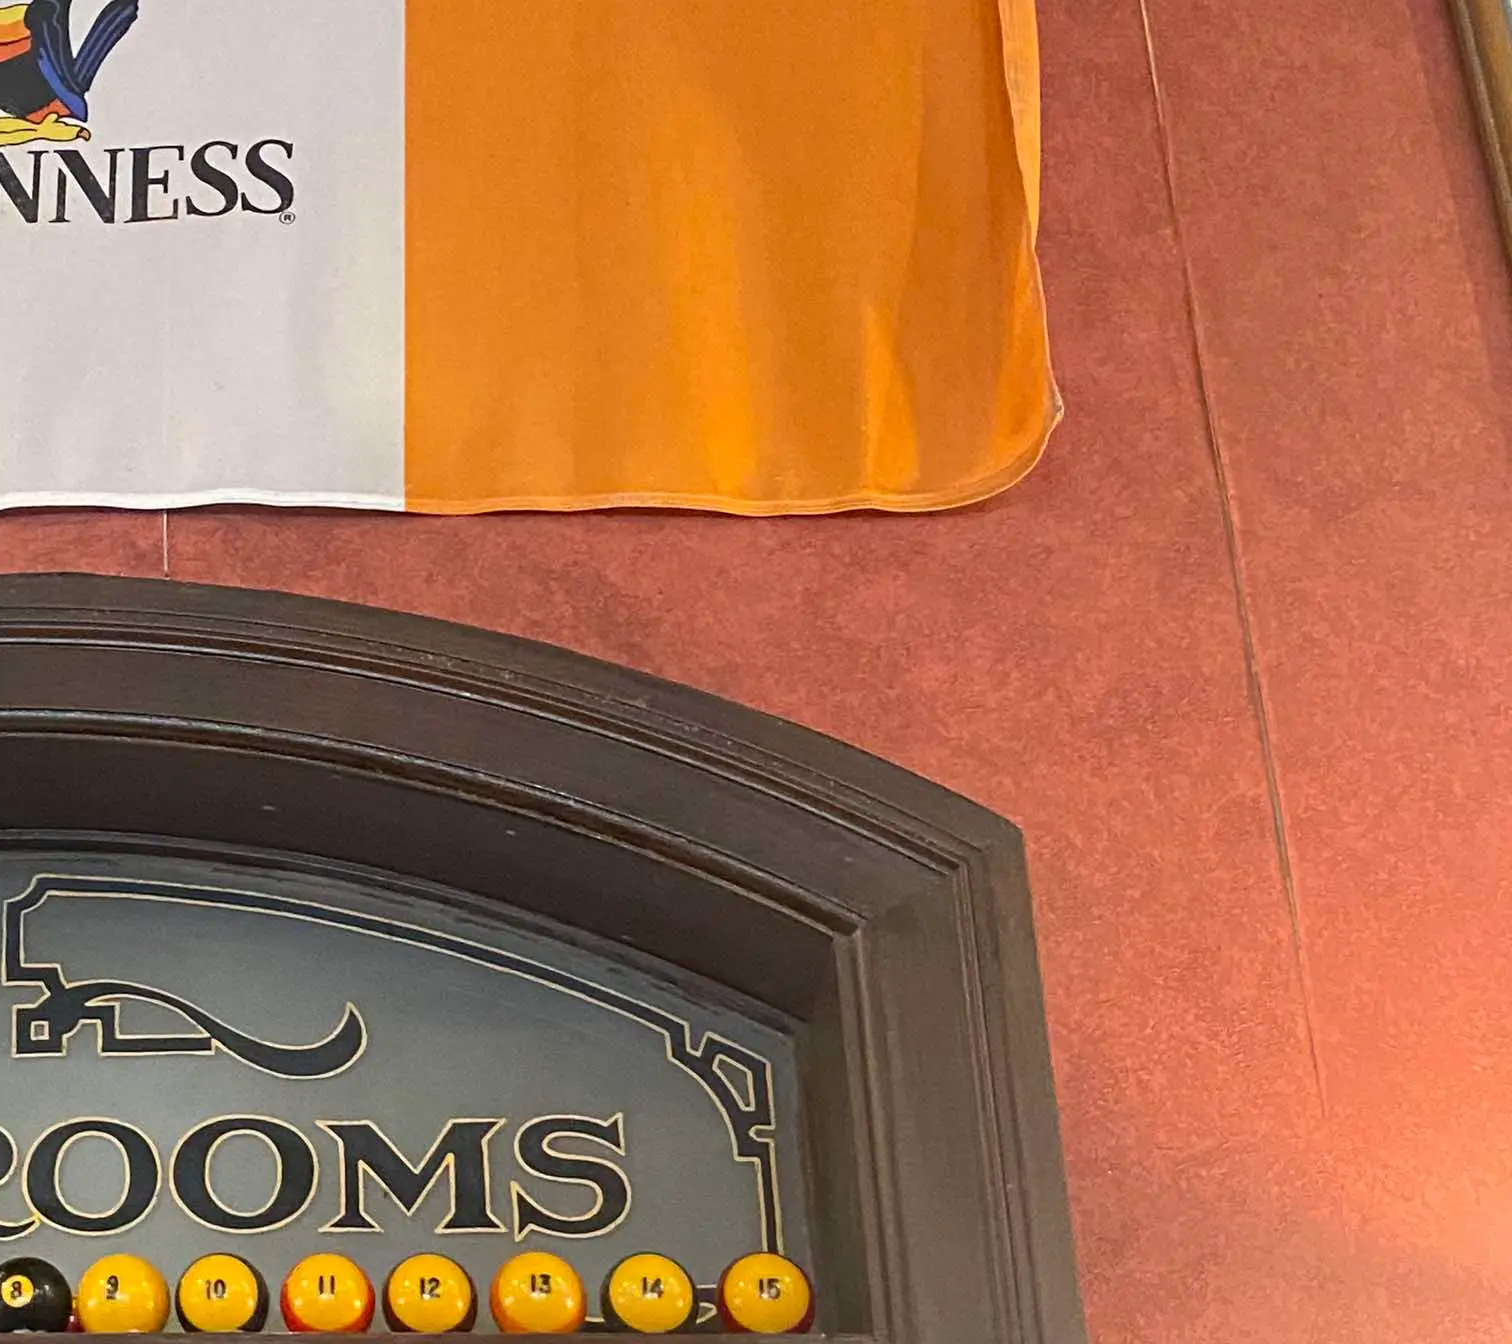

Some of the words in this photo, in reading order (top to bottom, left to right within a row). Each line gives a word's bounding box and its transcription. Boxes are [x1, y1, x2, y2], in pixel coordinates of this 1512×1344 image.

[11, 1281, 22, 1299] 8
[205, 1279, 228, 1300] 10
[317, 1274, 337, 1297] 11
[419, 1277, 441, 1299] 12
[530, 1273, 552, 1295] 13
[642, 1276, 665, 1299] 14
[758, 1278, 781, 1300] 15
